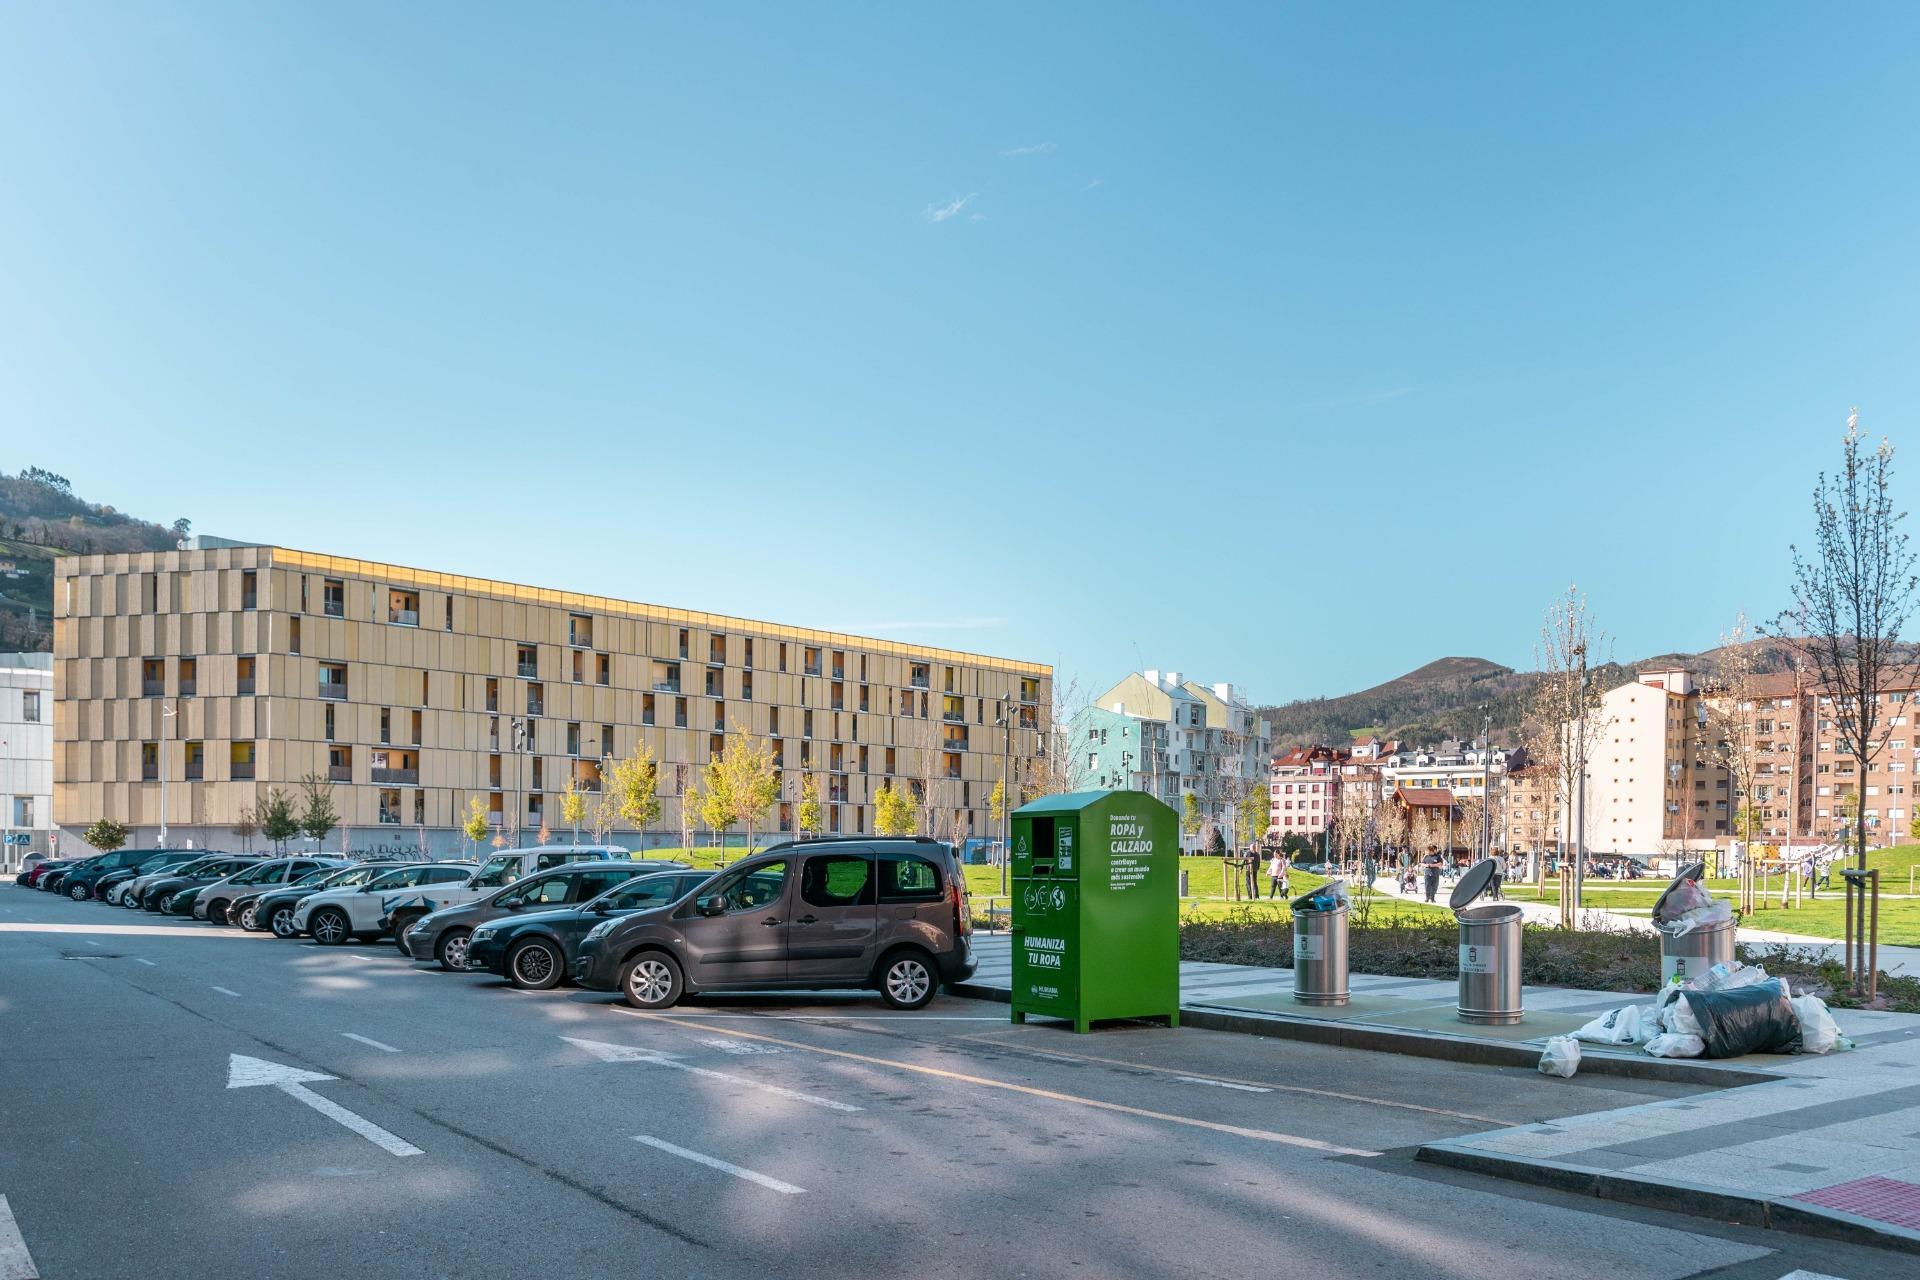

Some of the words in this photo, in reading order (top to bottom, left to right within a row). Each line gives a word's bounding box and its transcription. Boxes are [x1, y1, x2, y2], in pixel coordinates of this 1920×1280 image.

[1110, 824, 1136, 836] ROPA
[1137, 826, 1144, 838] y
[1111, 840, 1153, 853] CALZADO
[1024, 936, 1065, 950] HUMANIZA
[1028, 952, 1038, 963] TU
[1040, 954, 1060, 966] ROPA
